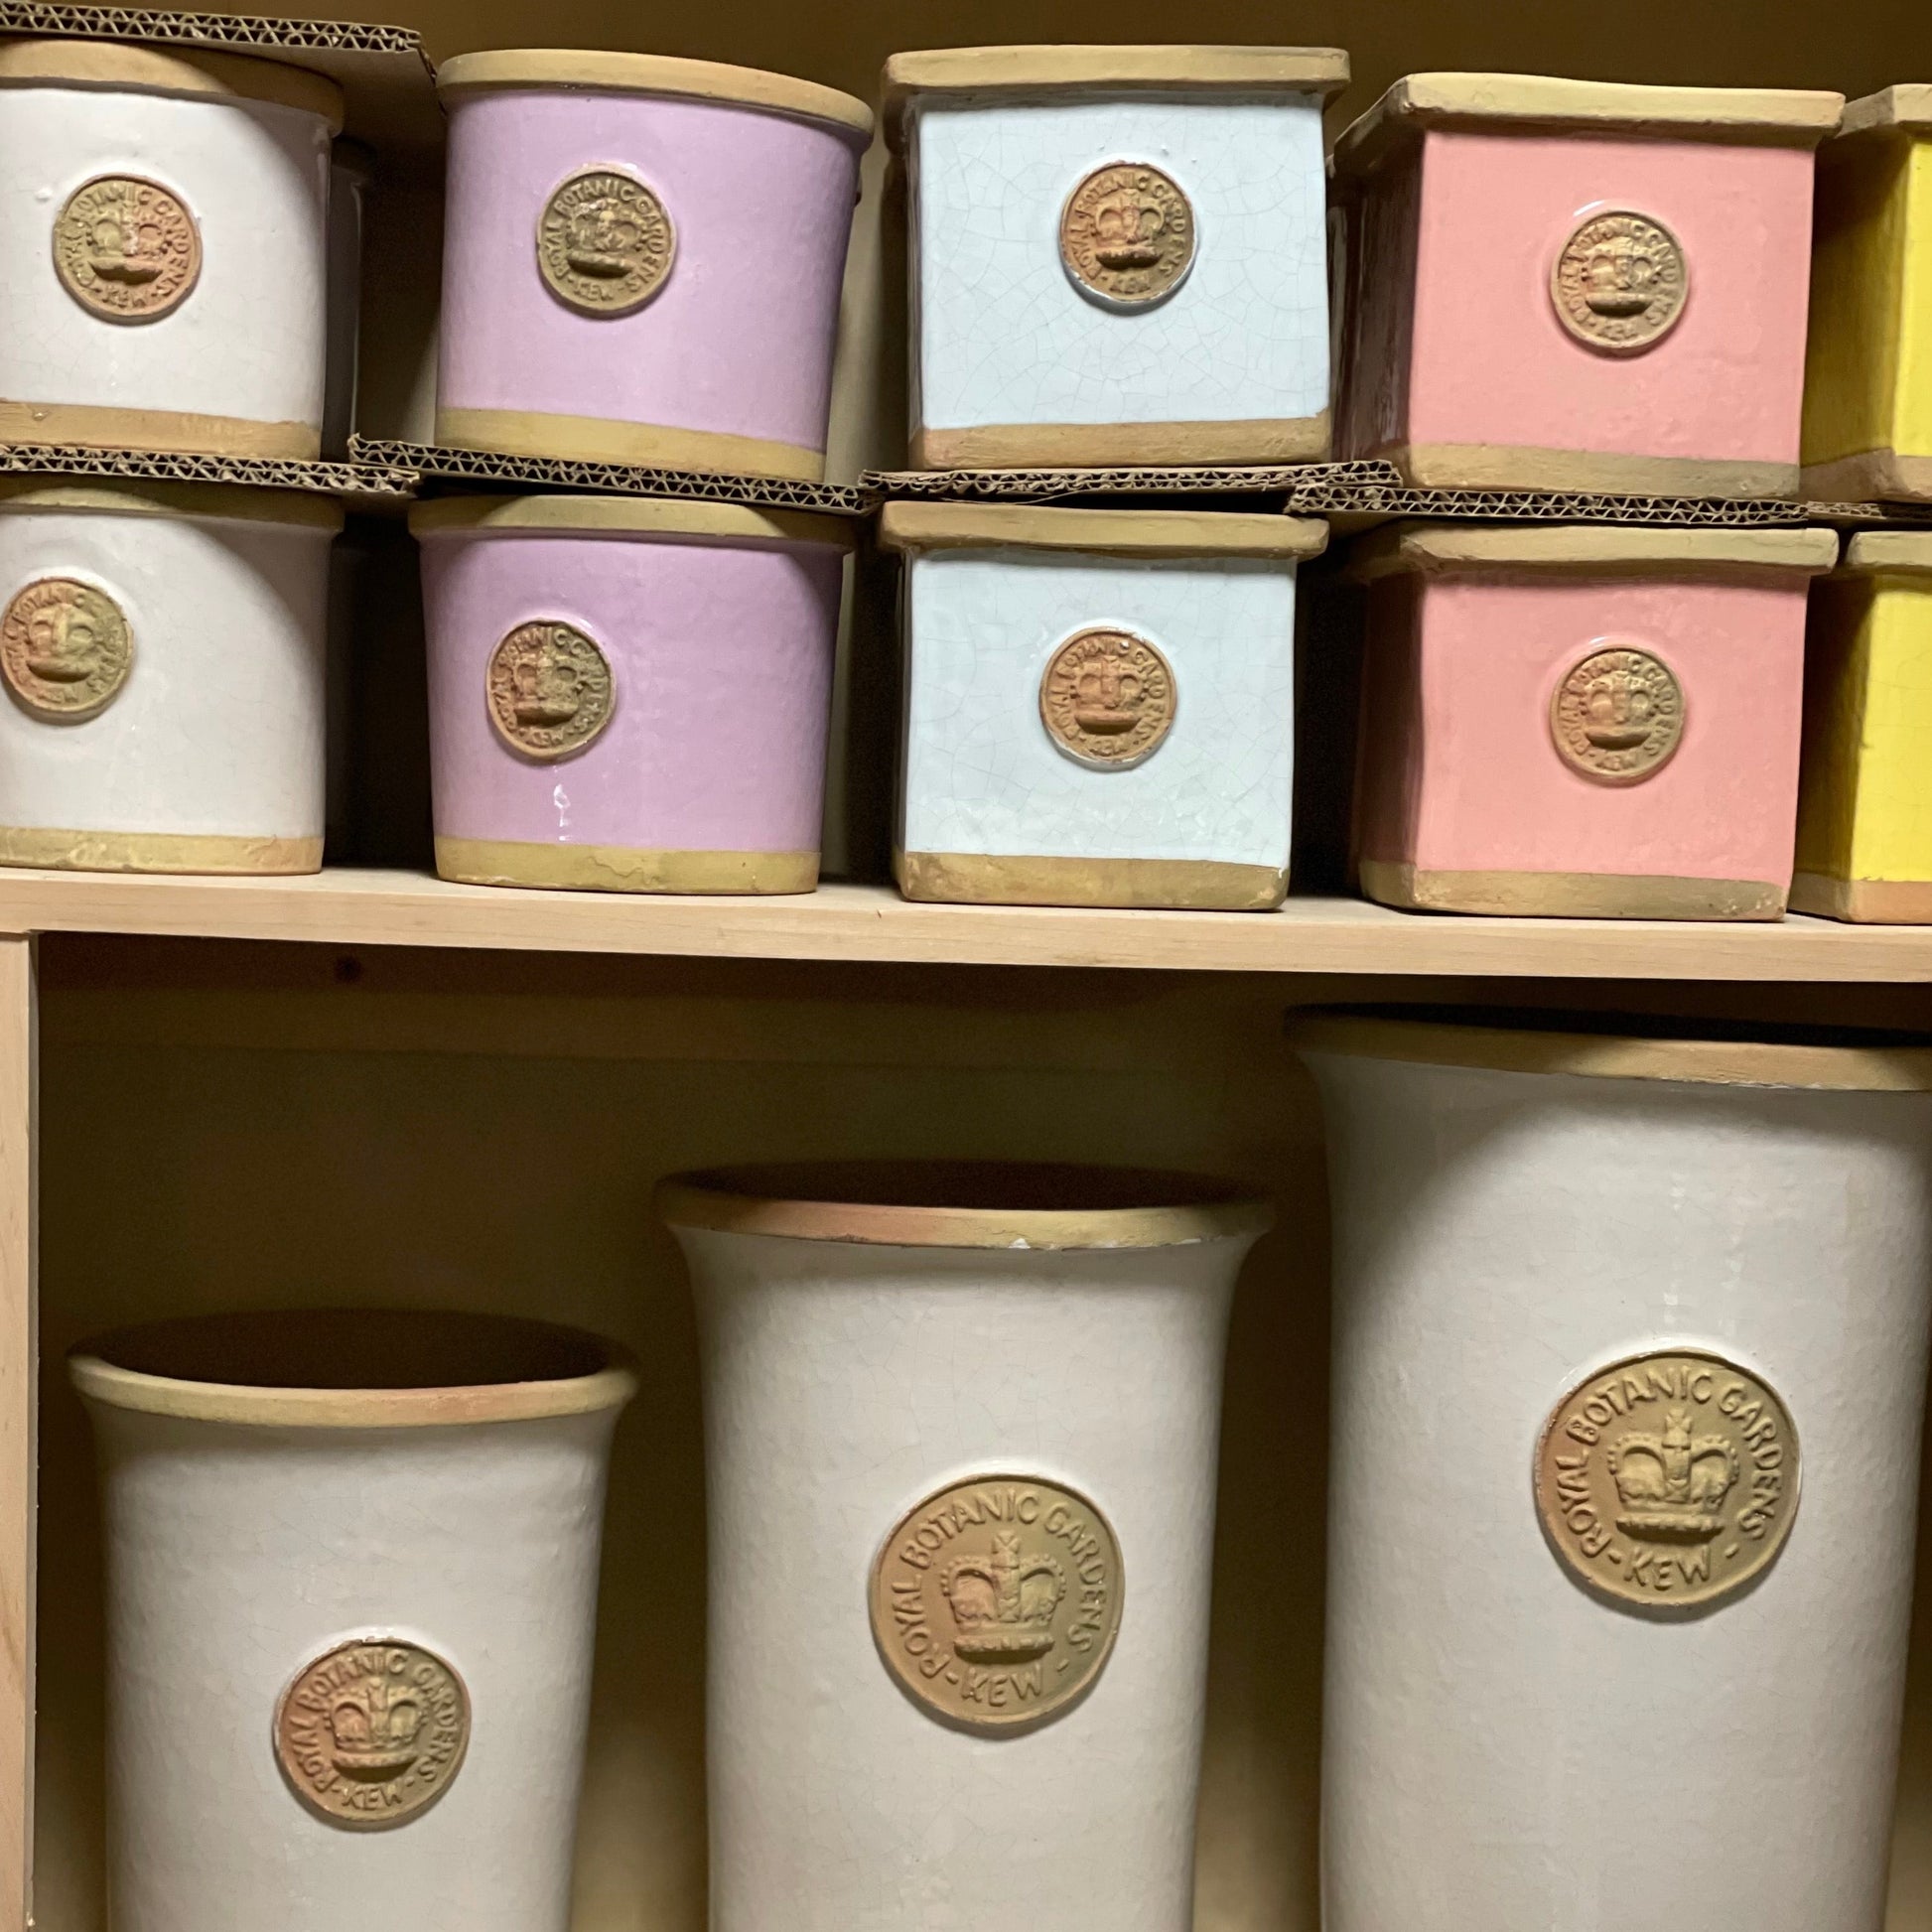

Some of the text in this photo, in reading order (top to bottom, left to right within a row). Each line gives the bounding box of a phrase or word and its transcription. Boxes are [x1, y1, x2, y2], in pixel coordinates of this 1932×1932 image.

[1555, 1365, 1783, 1559] ROYAL BOTANIC GARDENS
[891, 1489, 1106, 1679] ROYAL BOTANIC GARDENS
[1623, 1544, 1711, 1590] KEW
[298, 1647, 410, 1713] BOTANIC
[960, 1662, 1042, 1708] KEW
[288, 1711, 340, 1793] ROYAL
[341, 1783, 403, 1811] KEW
